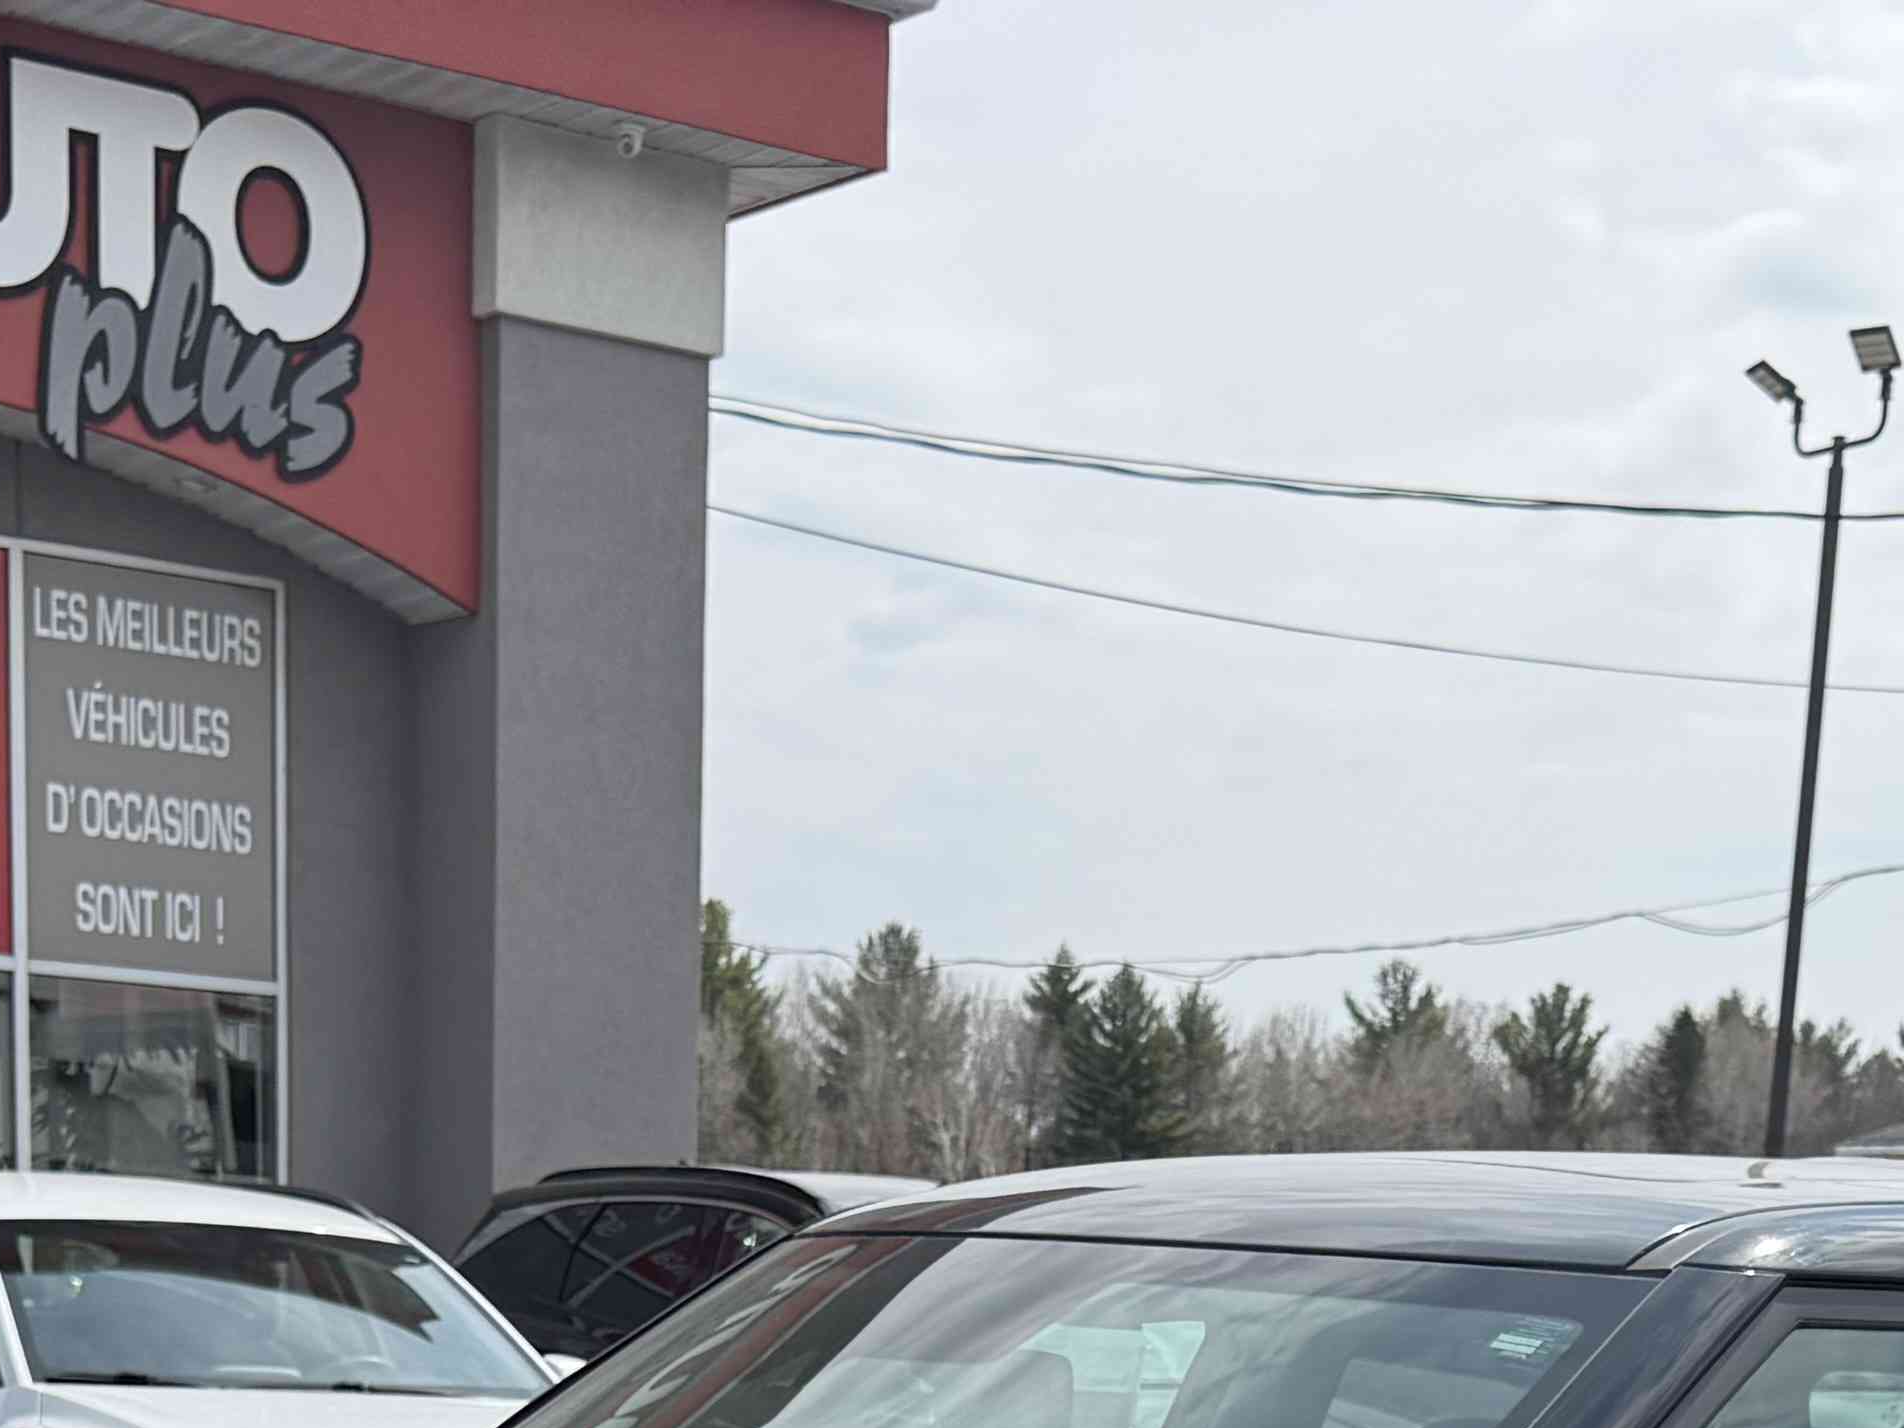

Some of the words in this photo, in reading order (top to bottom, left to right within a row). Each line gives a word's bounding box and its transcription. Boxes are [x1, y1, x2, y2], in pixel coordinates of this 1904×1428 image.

[44, 212, 360, 472] plus
[32, 586, 88, 643] LES
[97, 595, 262, 668] MEILLEURS
[65, 681, 231, 759] VÉHICULES
[75, 882, 159, 938] SONT
[165, 891, 201, 943] ICI
[215, 897, 226, 945] !
